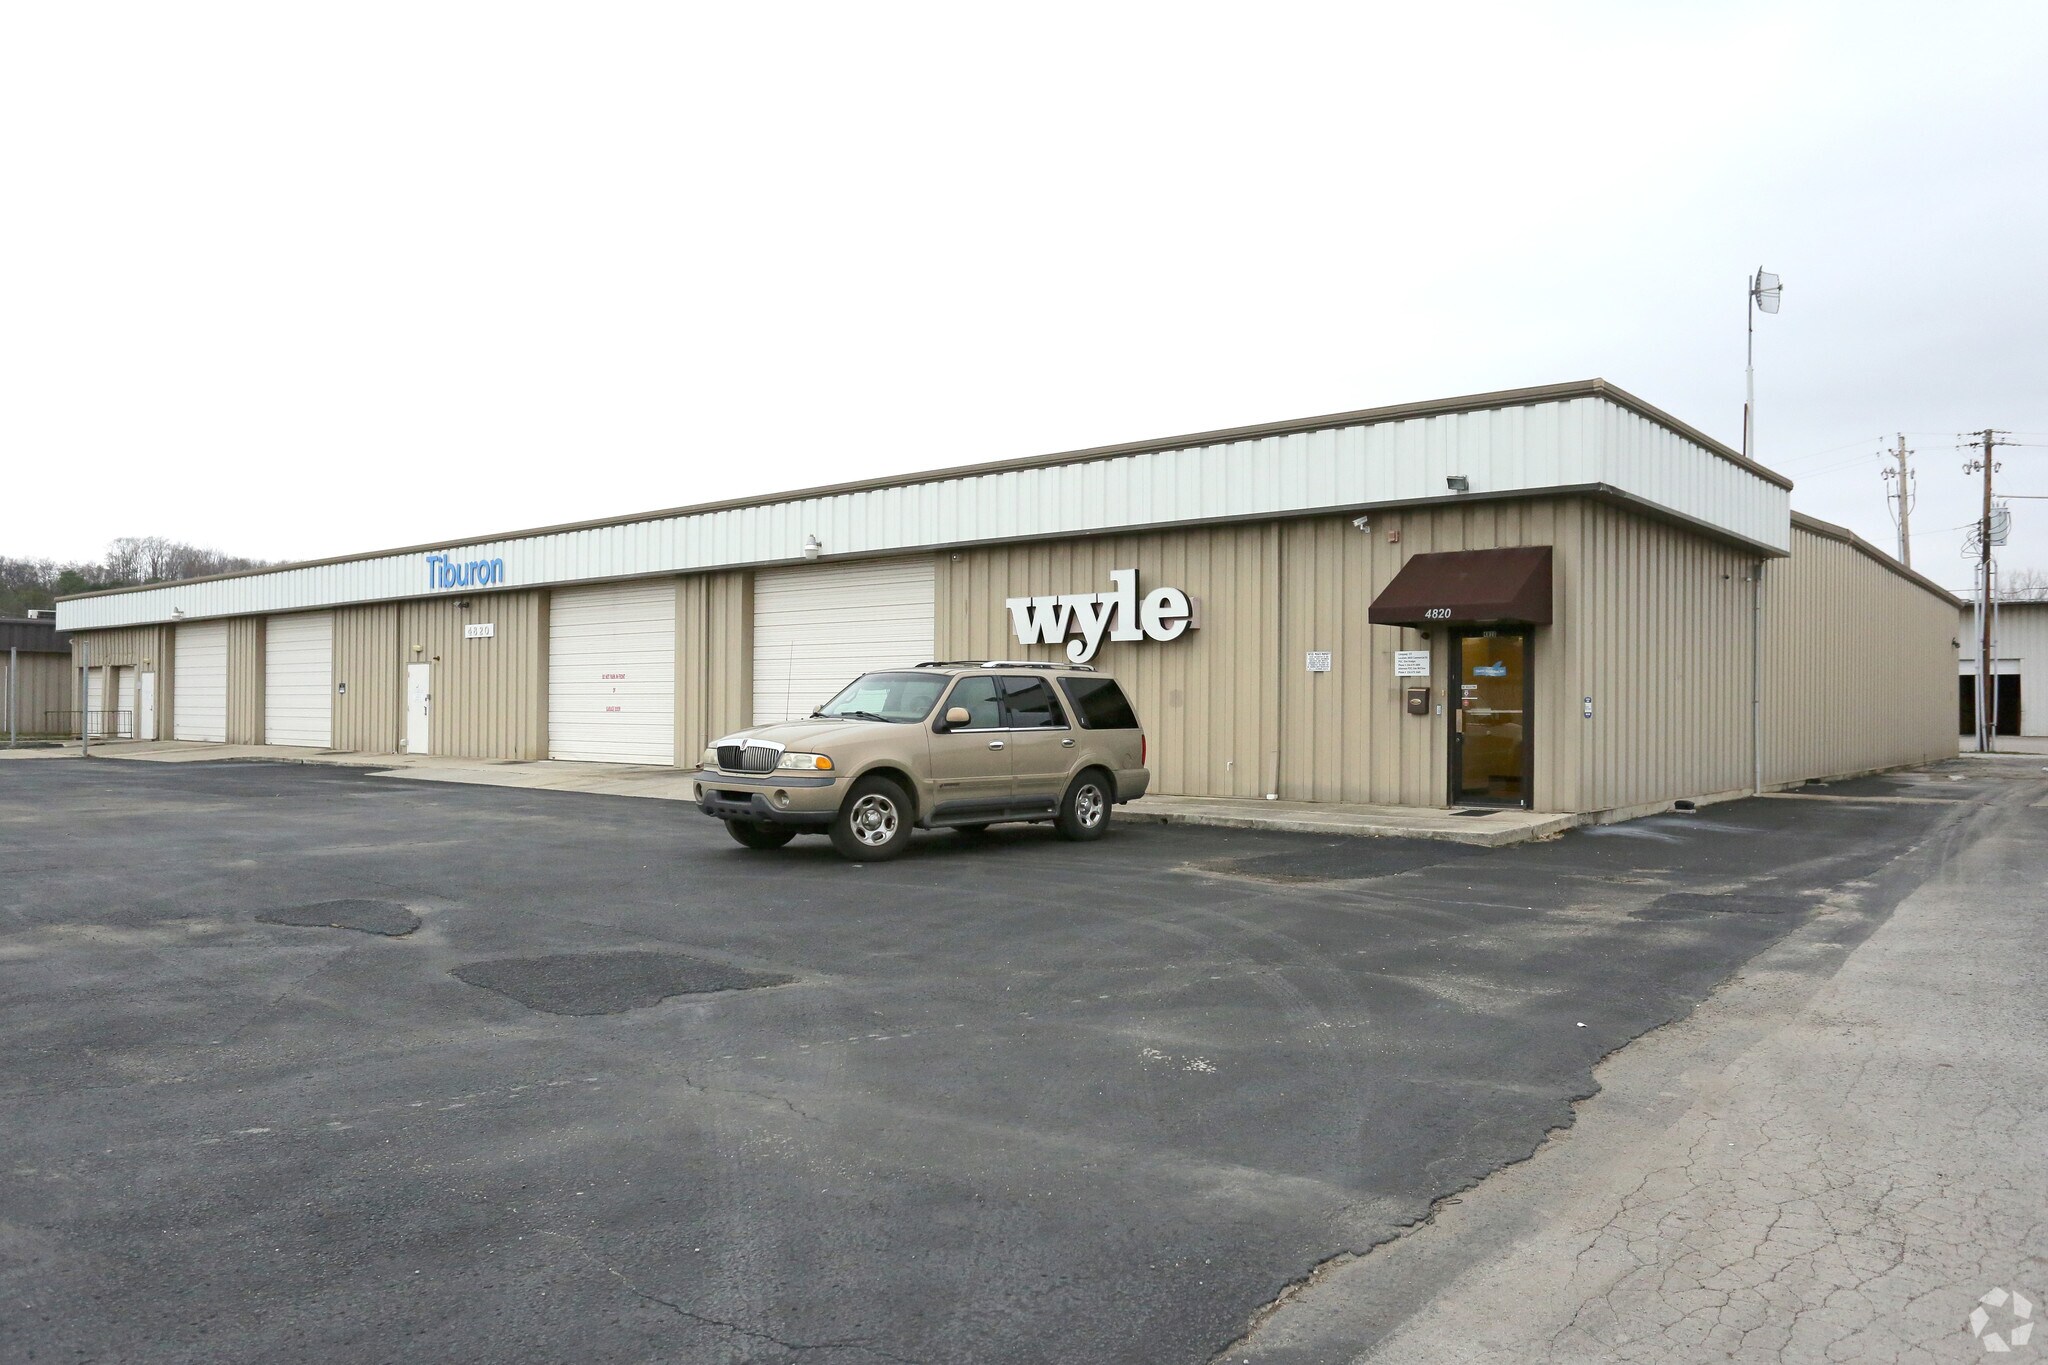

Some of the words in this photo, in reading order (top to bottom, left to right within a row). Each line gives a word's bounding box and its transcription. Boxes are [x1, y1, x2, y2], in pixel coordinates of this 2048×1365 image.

[426, 554, 504, 589] Tiburon
[1006, 569, 1192, 663] wyle
[1424, 608, 1452, 619] 4820
[467, 626, 490, 637] 4820
